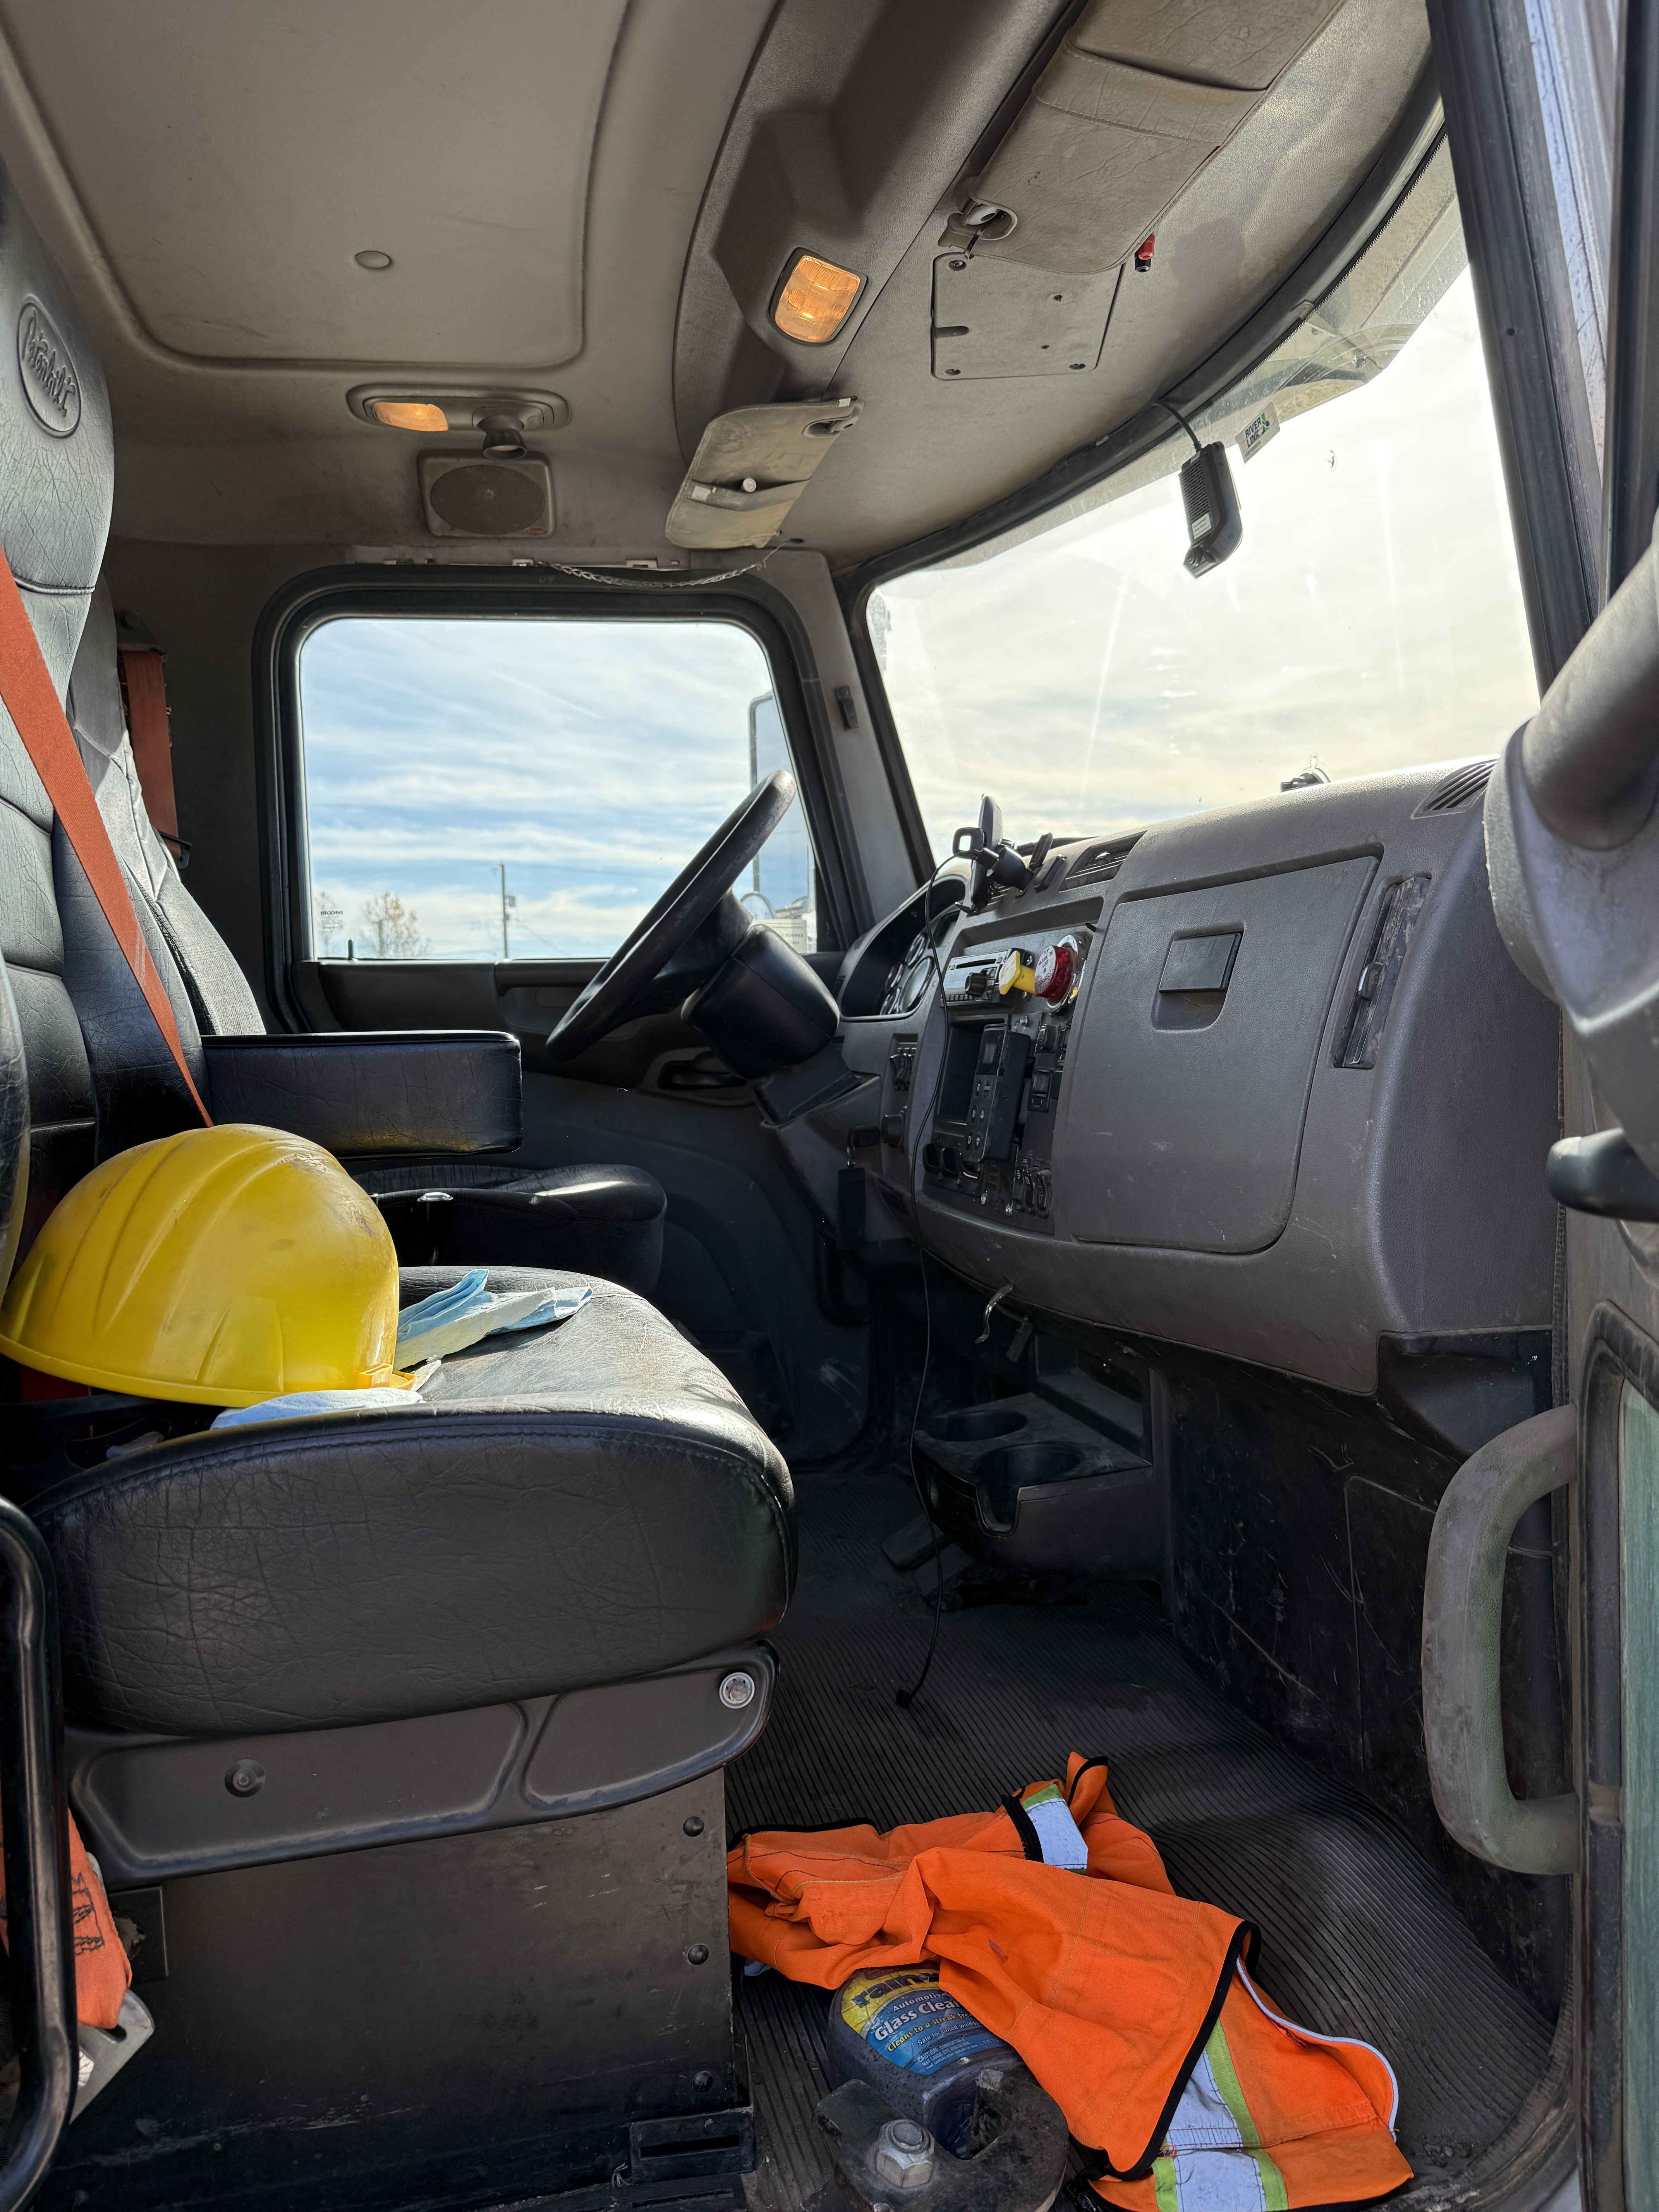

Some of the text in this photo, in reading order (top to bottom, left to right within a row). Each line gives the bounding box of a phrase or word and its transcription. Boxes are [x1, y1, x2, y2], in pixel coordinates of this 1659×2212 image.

[1245, 417, 1262, 439] RIVER
[1247, 429, 1260, 448] LINK
[875, 2010, 917, 2040] Glass
[917, 2036, 931, 2045] Safe
[941, 2025, 958, 2035] tinted
[887, 2031, 914, 2051] Cleans
[913, 2025, 924, 2033] to
[917, 2047, 939, 2063] CAUTION:
[930, 2052, 943, 2061] CAUSE
